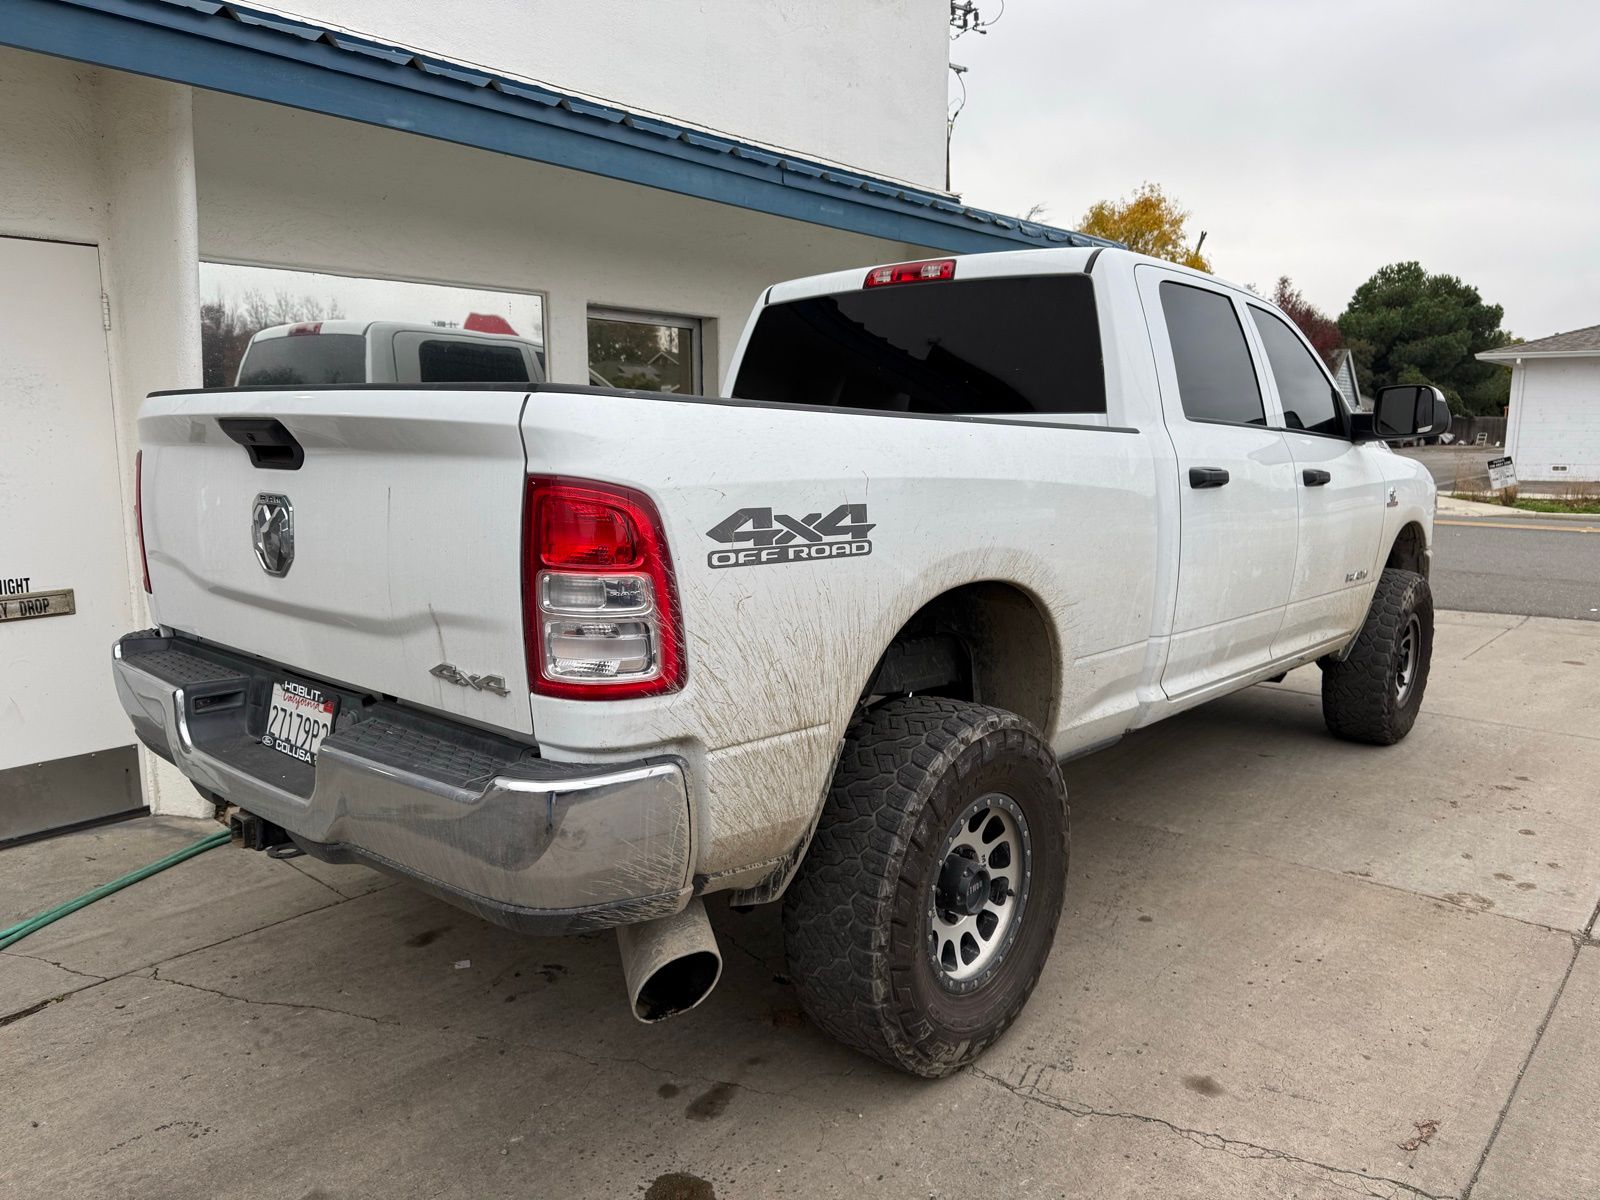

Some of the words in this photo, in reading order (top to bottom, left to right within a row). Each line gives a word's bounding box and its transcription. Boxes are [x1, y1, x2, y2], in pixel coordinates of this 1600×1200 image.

[711, 549, 781, 566] OFF
[788, 542, 870, 560] ROAD
[19, 598, 50, 616] DROP
[284, 680, 321, 702] HOBLIT
[275, 740, 312, 764] COLUSA
